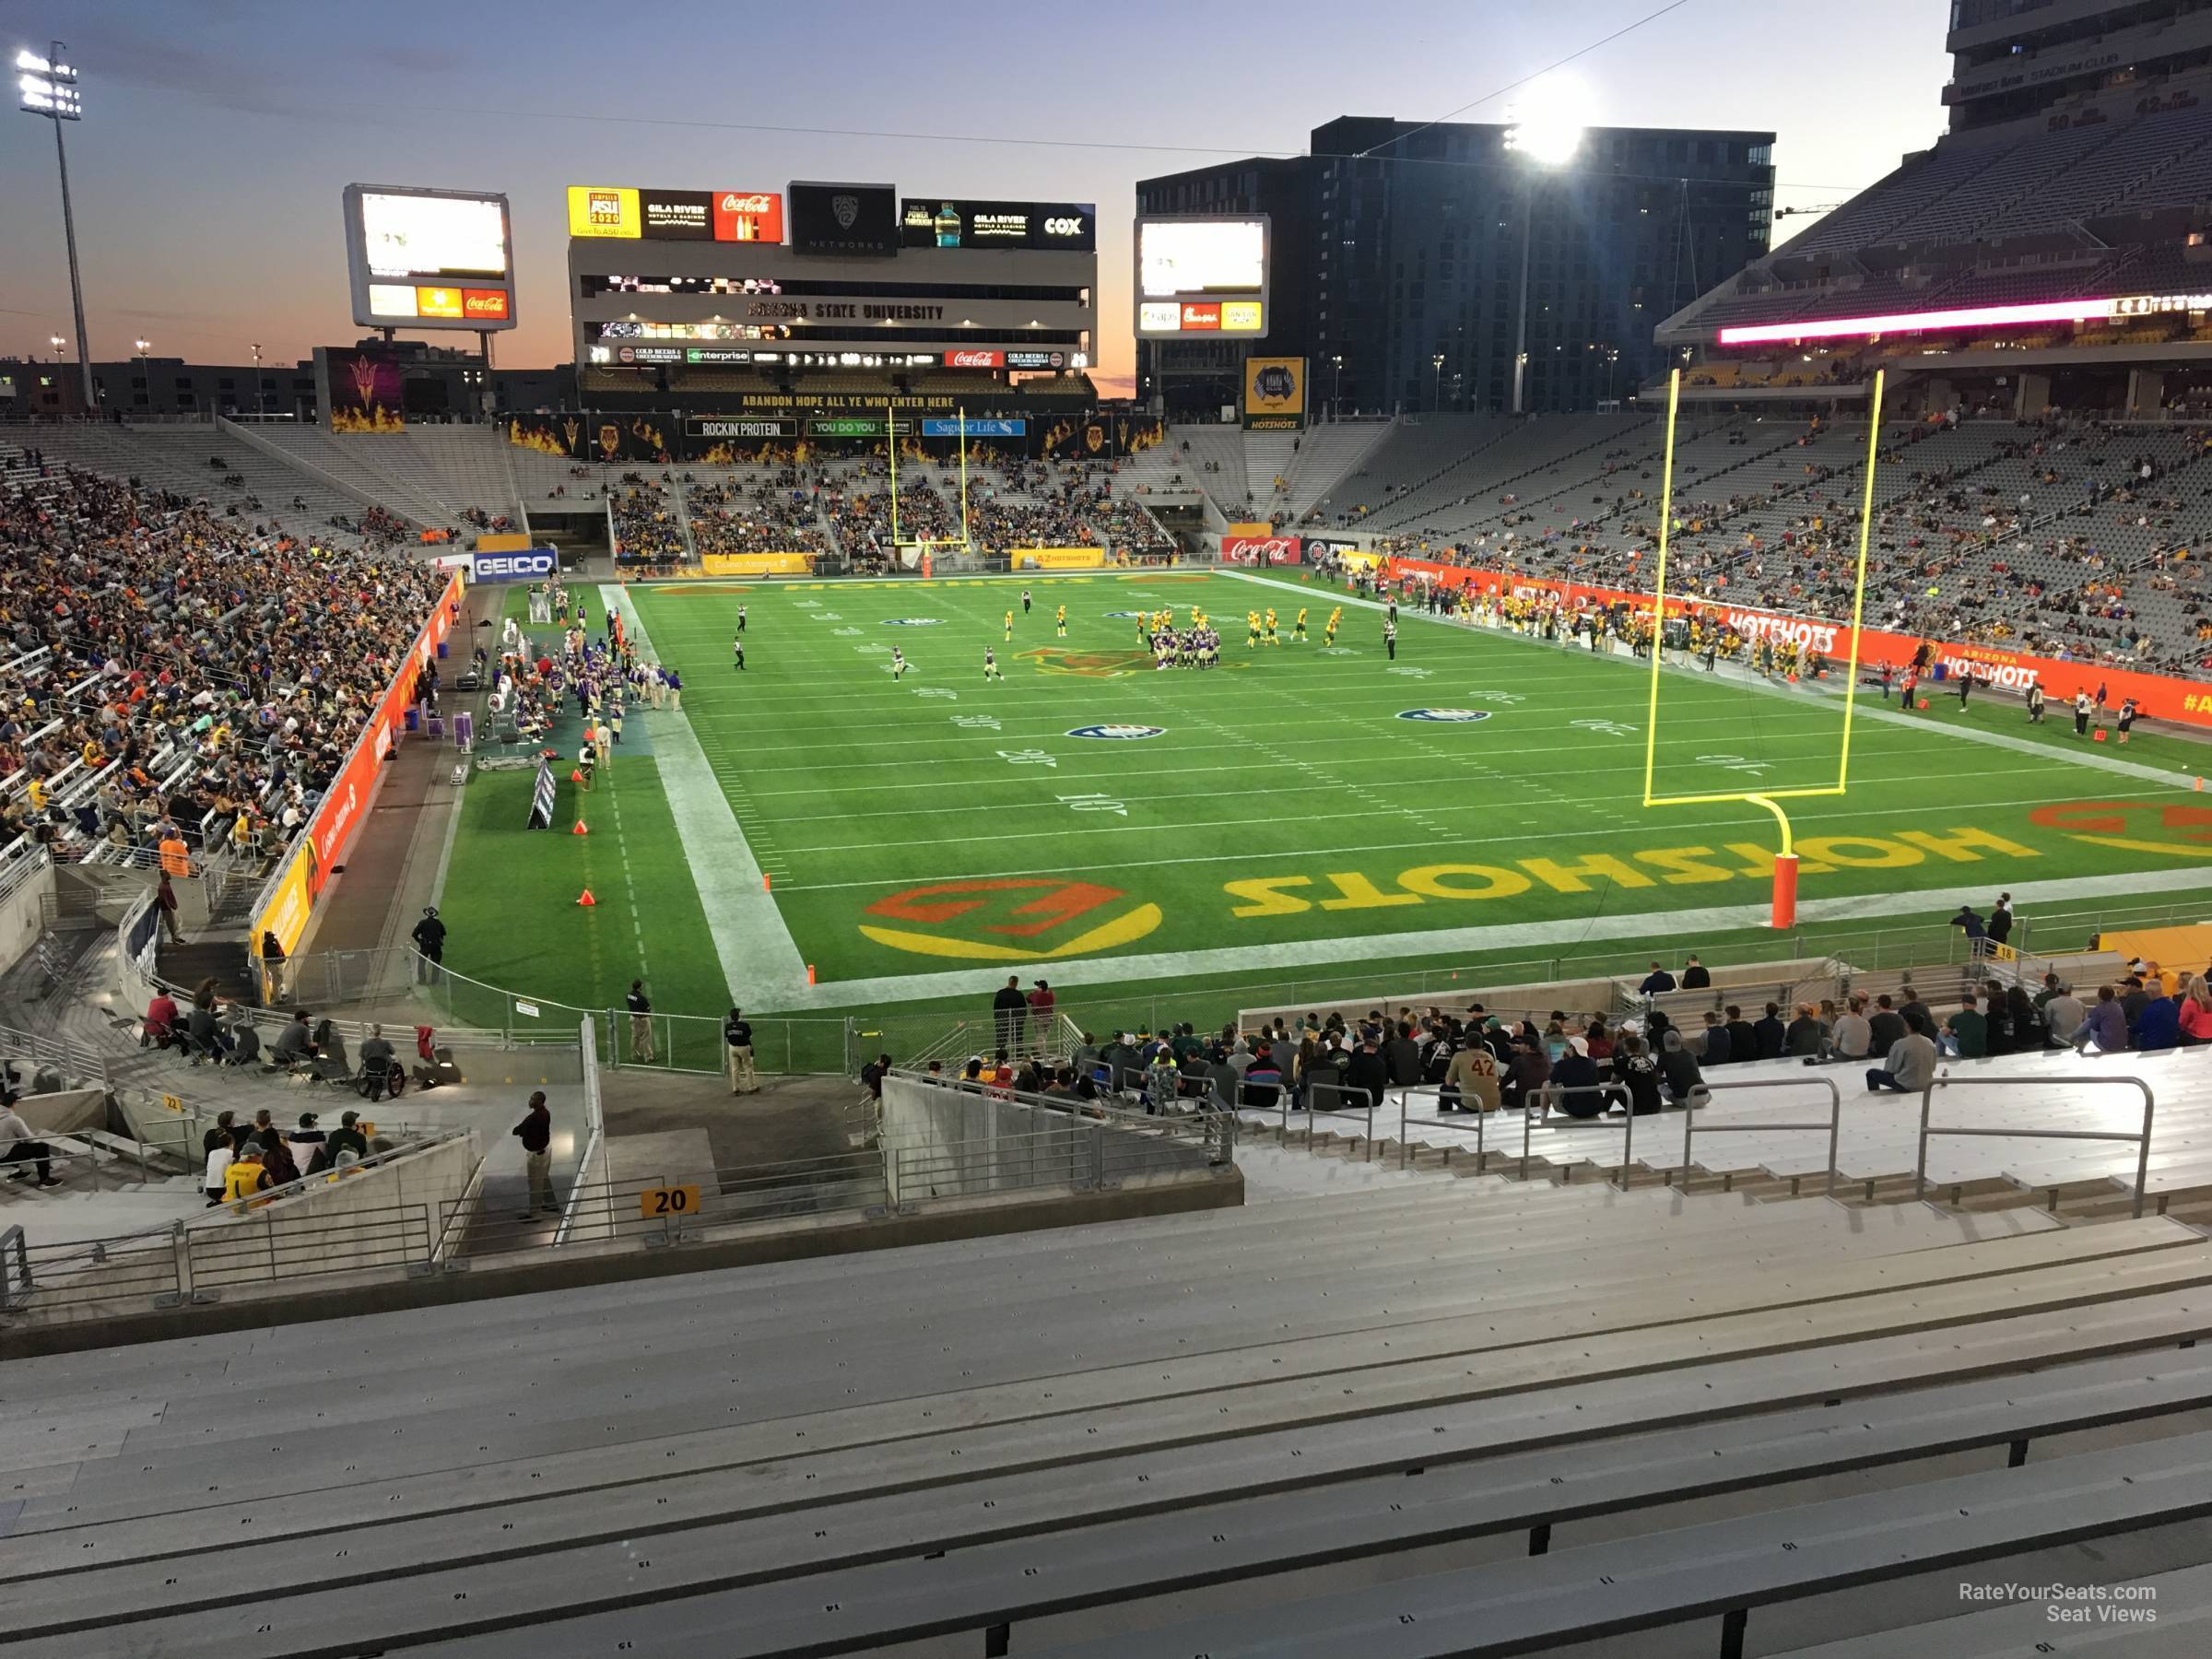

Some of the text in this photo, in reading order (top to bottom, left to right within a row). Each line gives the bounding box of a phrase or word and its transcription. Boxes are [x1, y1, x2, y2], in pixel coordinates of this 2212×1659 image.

[2031, 62, 2082, 81] STADIUM
[2085, 53, 2118, 69] CLUB
[591, 200, 618, 214] ASU
[648, 205, 705, 215] GILA RIVER
[591, 213, 619, 223] 2020
[973, 215, 1026, 225] GILA RIVER
[1044, 218, 1082, 236] COX
[809, 240, 884, 250] NETWORKS
[816, 303, 856, 319] STATE
[864, 304, 944, 320] UNIVERSITY
[691, 351, 748, 361] enterprise
[742, 395, 955, 407] ABANDON HOPE ALL YE WHO ENTER HERE
[740, 423, 781, 436] PROTEIN
[816, 423, 836, 432] YOU
[838, 423, 853, 432] DO
[855, 423, 876, 432] YOU
[977, 420, 996, 432] Life
[1252, 420, 1297, 429] HOTSHOTS
[476, 556, 553, 576] GEICO
[1728, 611, 1837, 653] HOTSHOTS
[1963, 649, 2017, 664] ARIZONA
[1223, 826, 2042, 917] HOTSHOTS
[2002, 947, 2012, 959] 18
[1471, 1059, 1494, 1077] 42
[166, 1097, 178, 1110] 22
[655, 1189, 687, 1213] 20
